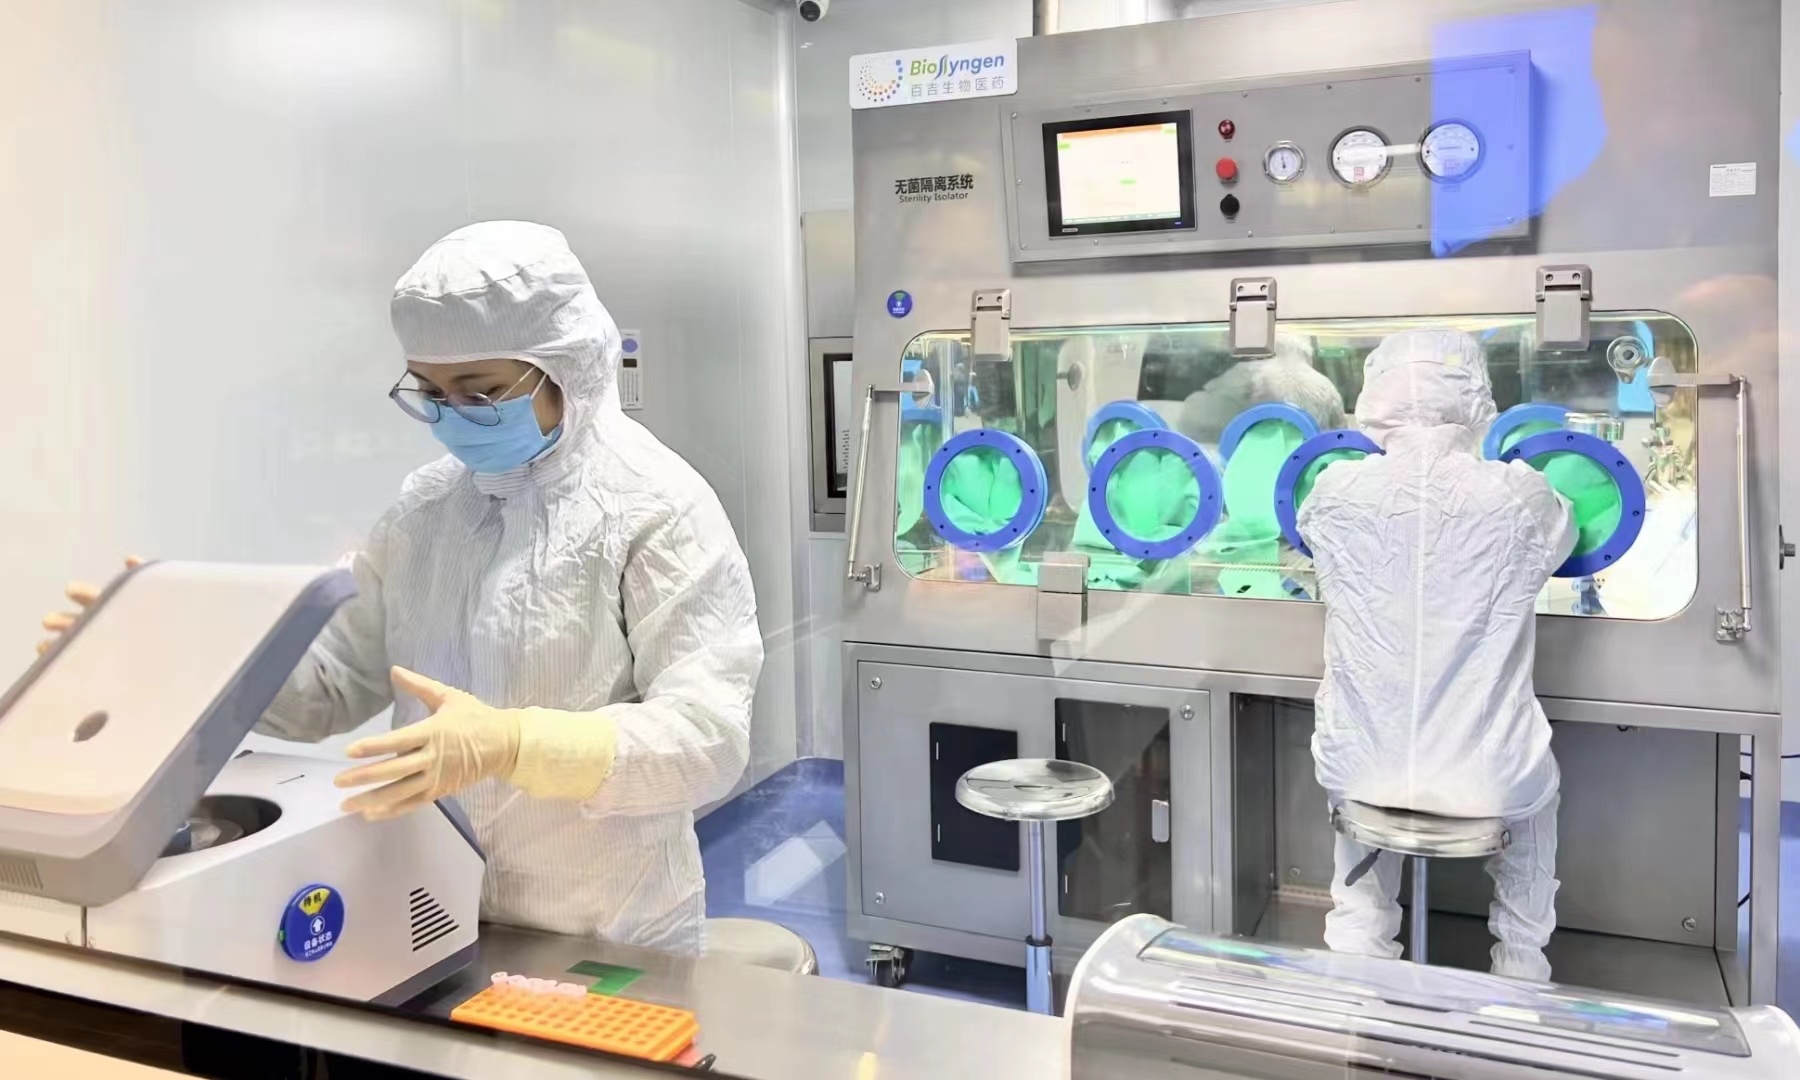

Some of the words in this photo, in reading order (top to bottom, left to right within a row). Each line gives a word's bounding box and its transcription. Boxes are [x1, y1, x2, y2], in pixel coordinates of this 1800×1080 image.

[910, 54, 1004, 79] BioSyngen
[911, 76, 1004, 96] 百吉生物医药
[895, 173, 973, 194] 无菌隔离系统
[899, 194, 932, 203] Sterility
[935, 191, 969, 201] Isolator
[304, 892, 321, 908] 待机
